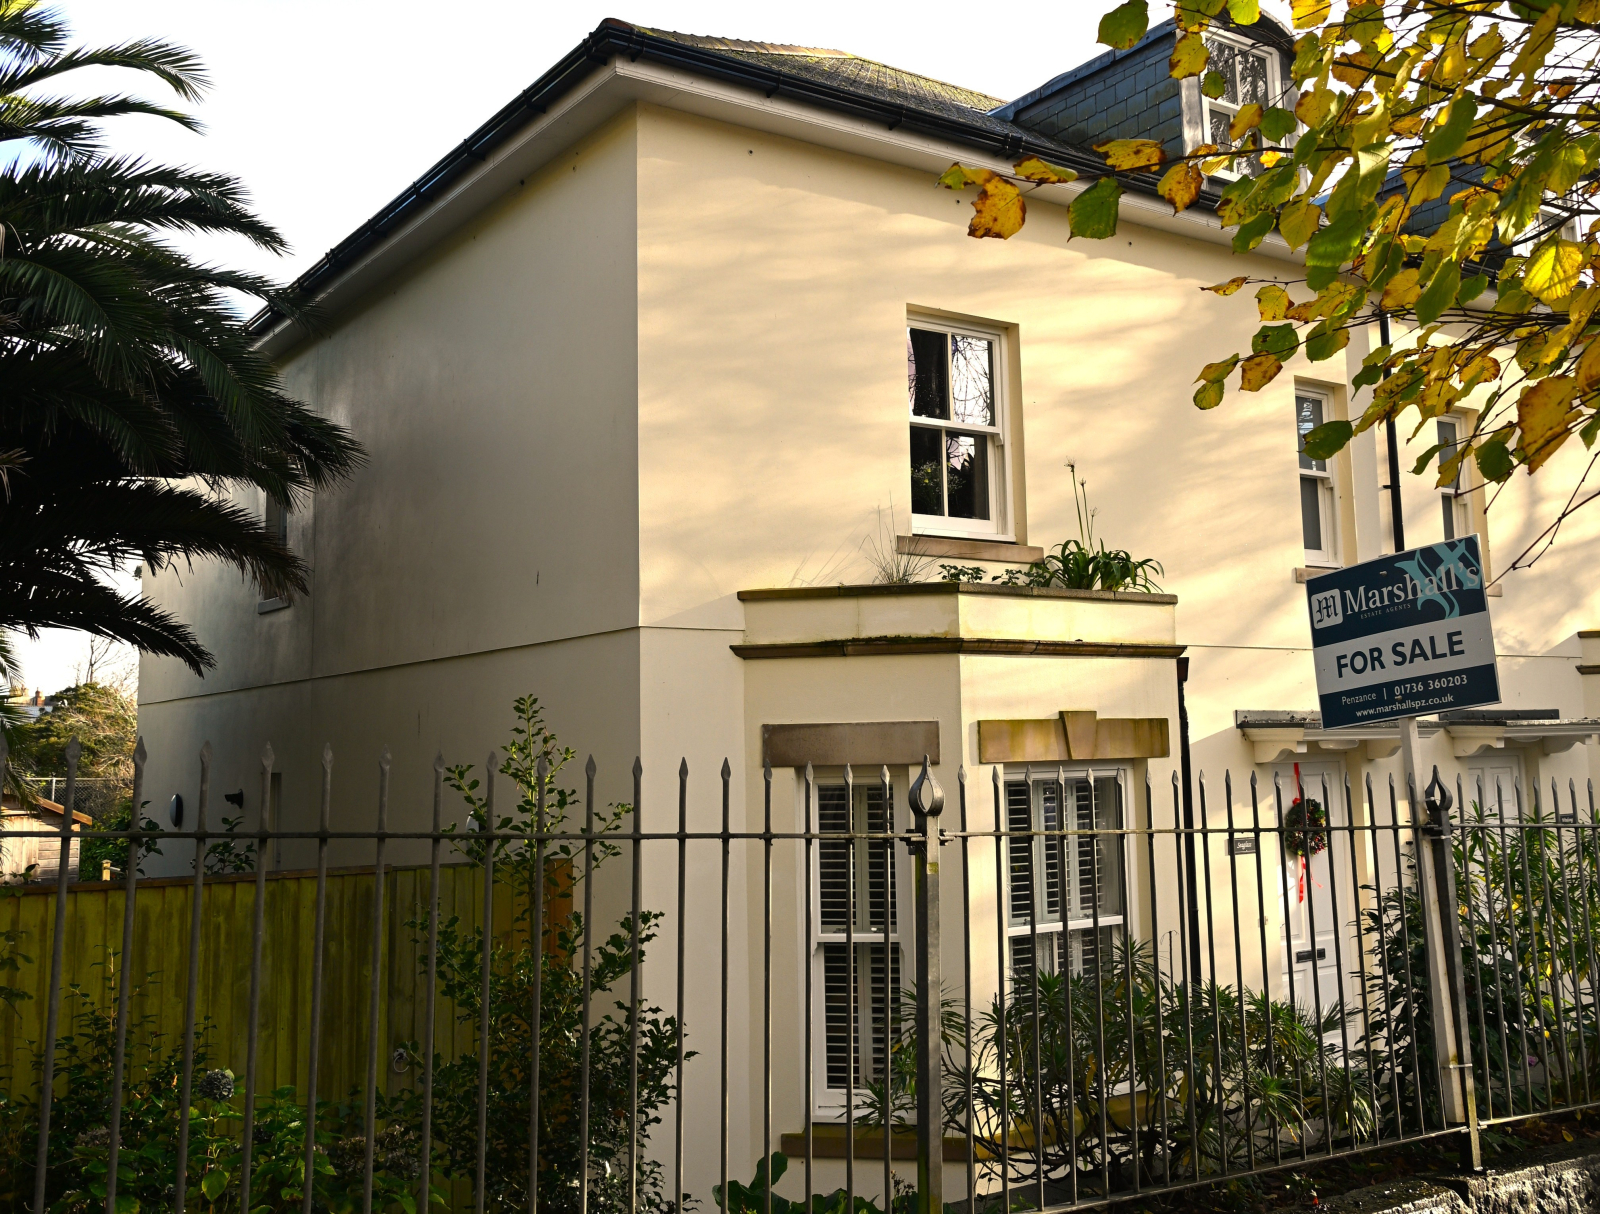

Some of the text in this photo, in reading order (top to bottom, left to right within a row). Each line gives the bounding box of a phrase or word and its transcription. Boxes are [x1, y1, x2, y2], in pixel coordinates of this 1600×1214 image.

[1343, 563, 1479, 614] Marshall's
[1360, 602, 1412, 619] ESTATE AGENTS
[1336, 630, 1465, 679] FOR SALE
[1341, 675, 1468, 705] Penzance 01736 360203
[1355, 694, 1454, 717] www.marshallspz.co.uk
